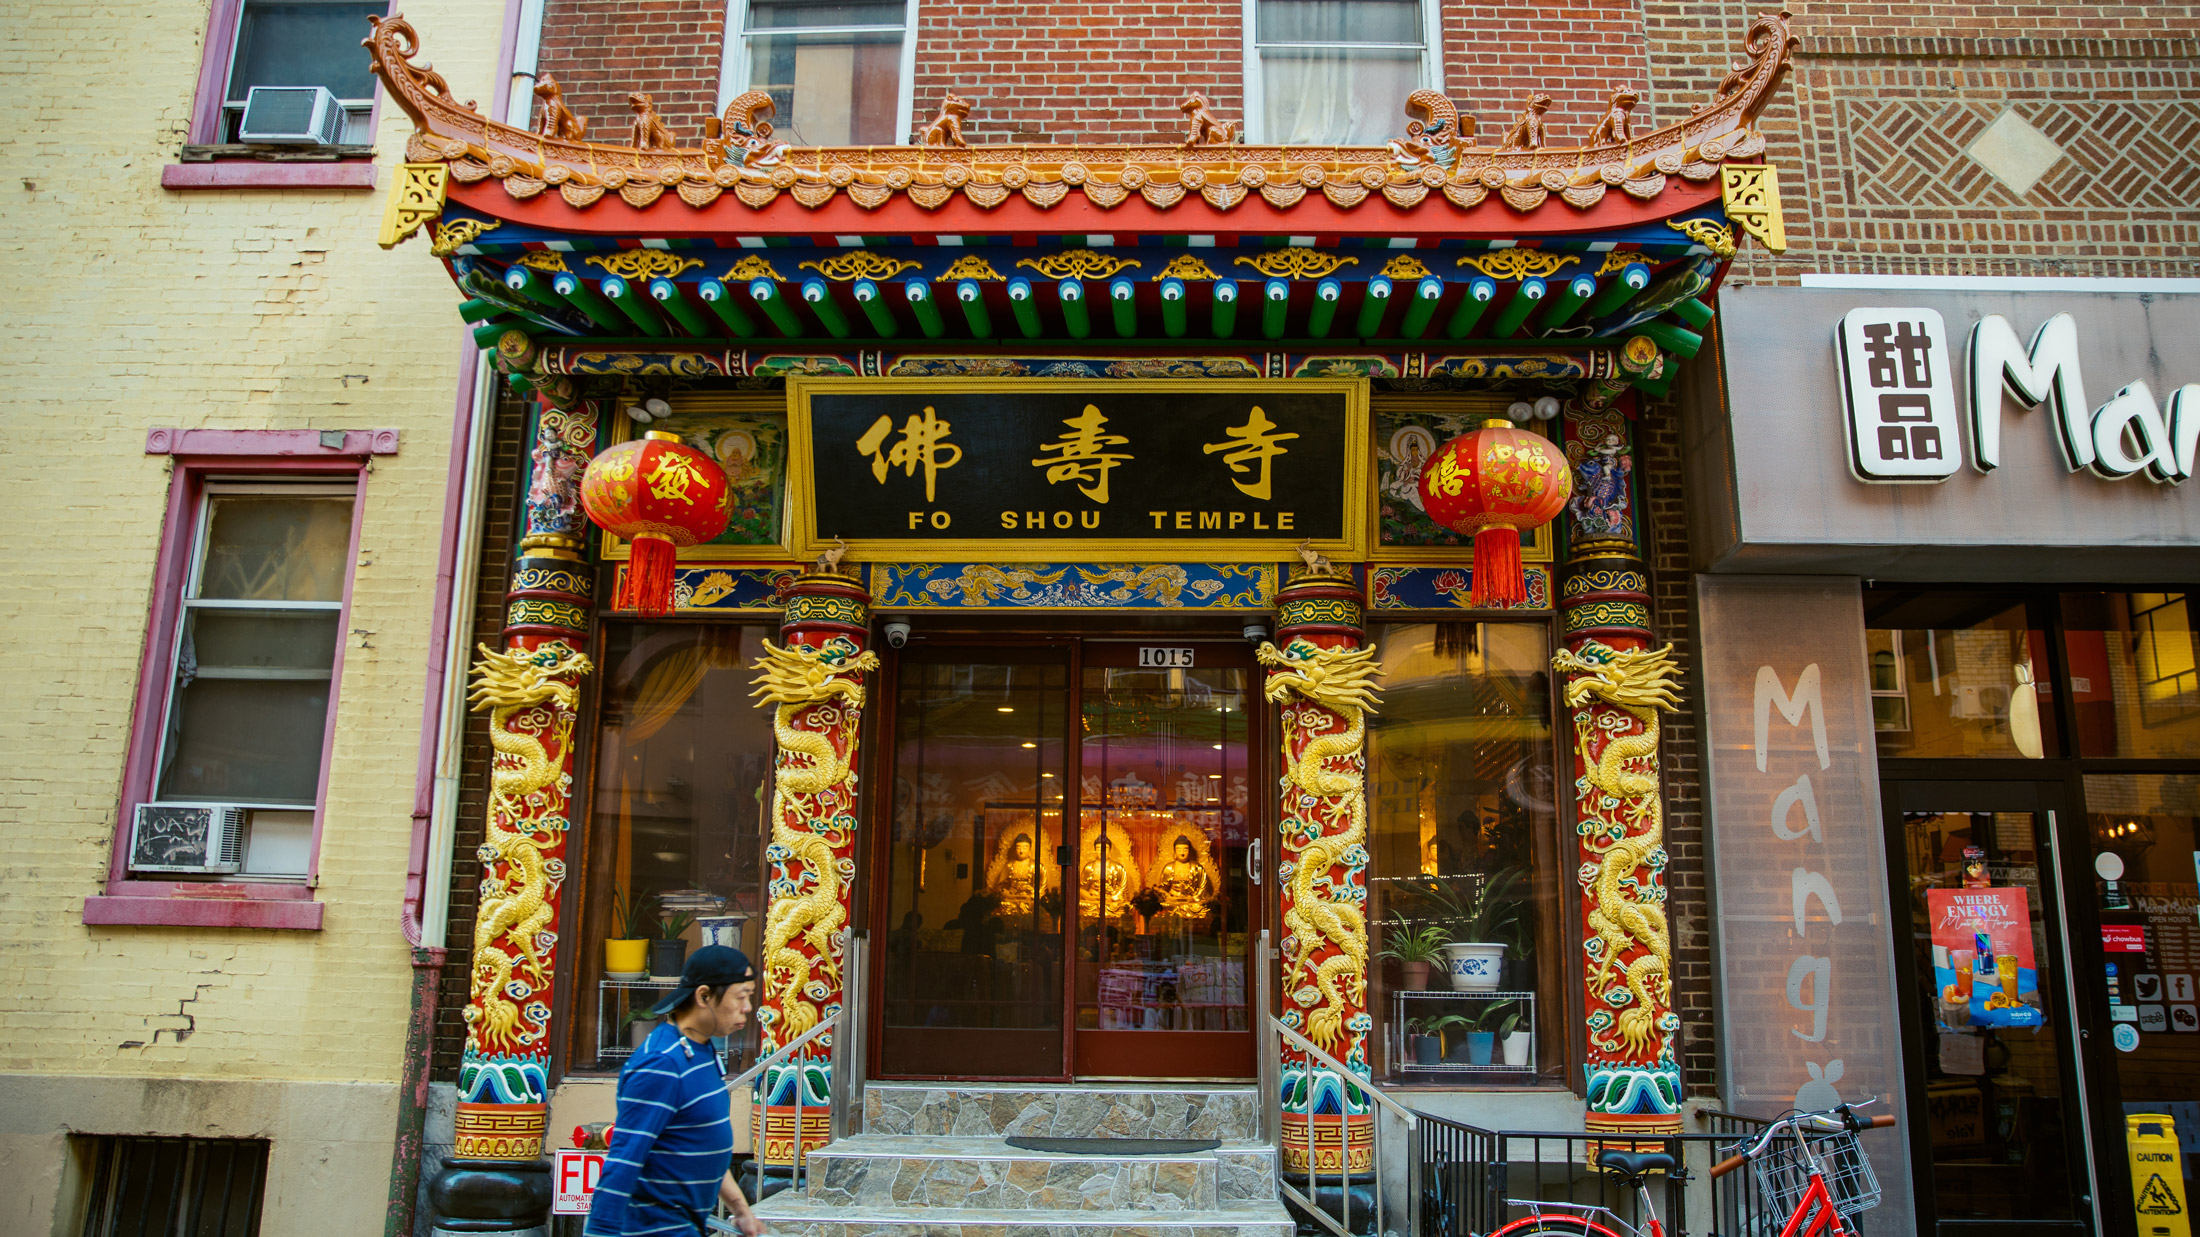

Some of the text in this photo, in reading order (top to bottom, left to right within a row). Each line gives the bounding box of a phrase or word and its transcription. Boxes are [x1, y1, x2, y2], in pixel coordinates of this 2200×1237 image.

[1863, 321, 1943, 461] 甜品
[908, 510, 1295, 530] FO SHOU TEMPLE
[1141, 649, 1194, 666] 1015
[1953, 894, 2001, 905] WHERE
[1946, 904, 2009, 918] ENERGY
[2112, 935, 2142, 943] chowbus
[2136, 1153, 2174, 1163] CAUTION
[2138, 1180, 2154, 1205] CAUTION
[2143, 1208, 2176, 1216] ATTENTION
